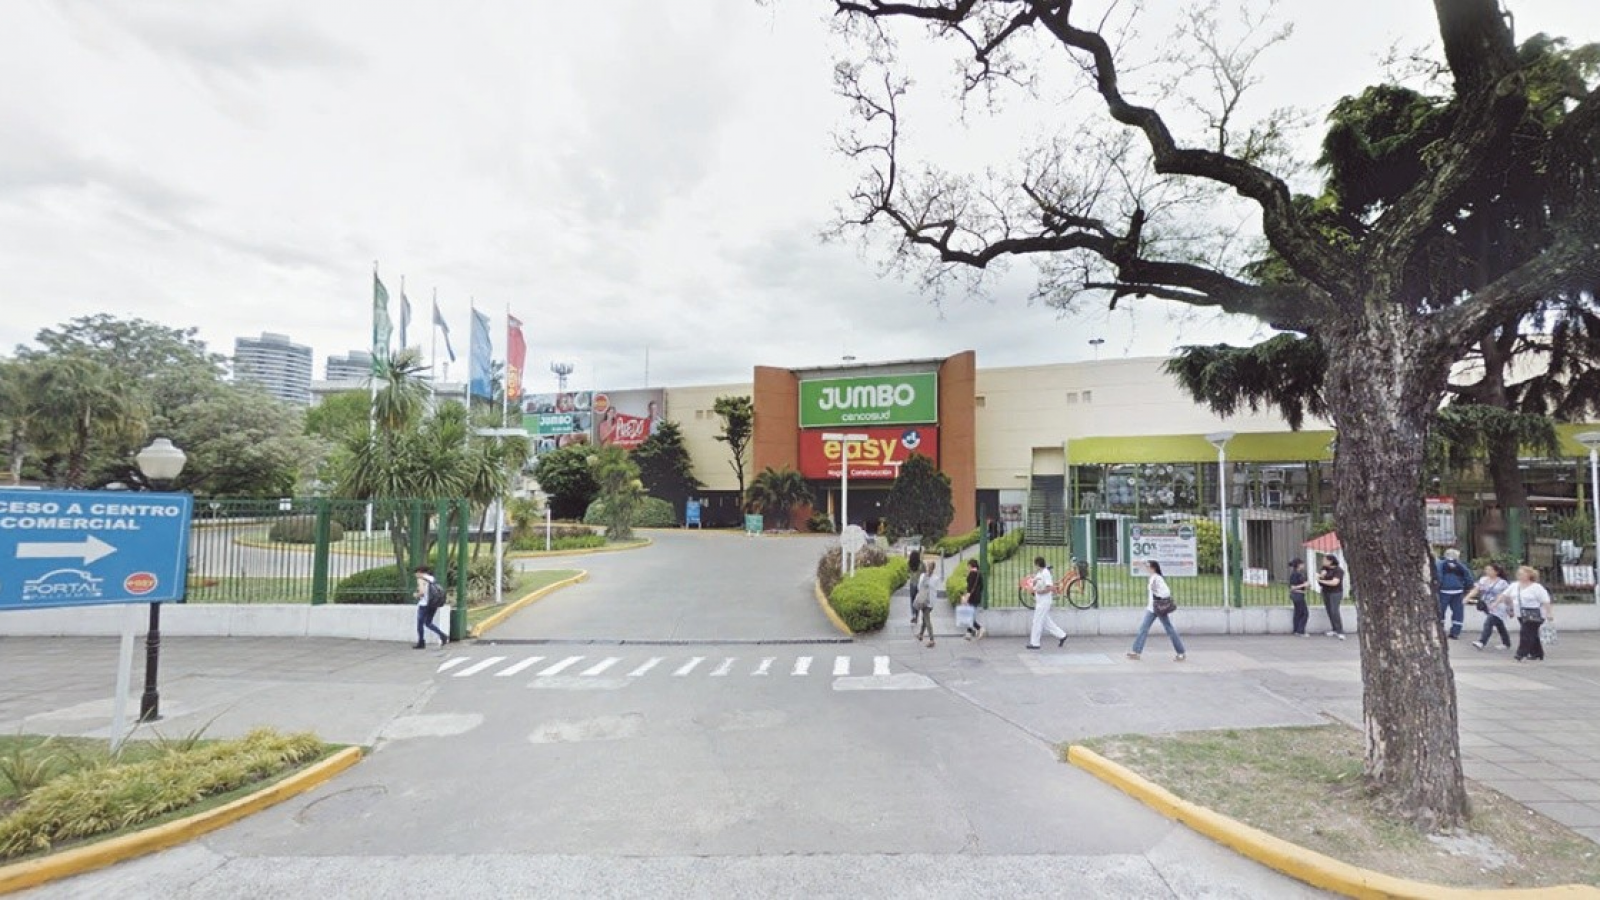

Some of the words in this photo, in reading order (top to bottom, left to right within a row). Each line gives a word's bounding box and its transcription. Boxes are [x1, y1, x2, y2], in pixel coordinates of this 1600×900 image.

[819, 383, 915, 410] JUMBO
[842, 410, 890, 422] cencosud
[824, 439, 897, 465] easy
[66, 503, 83, 515] A
[90, 504, 181, 517] CENTRO
[0, 517, 140, 530] COMERCIAL
[1133, 542, 1156, 555] 30%
[23, 583, 101, 595] PORTAL
